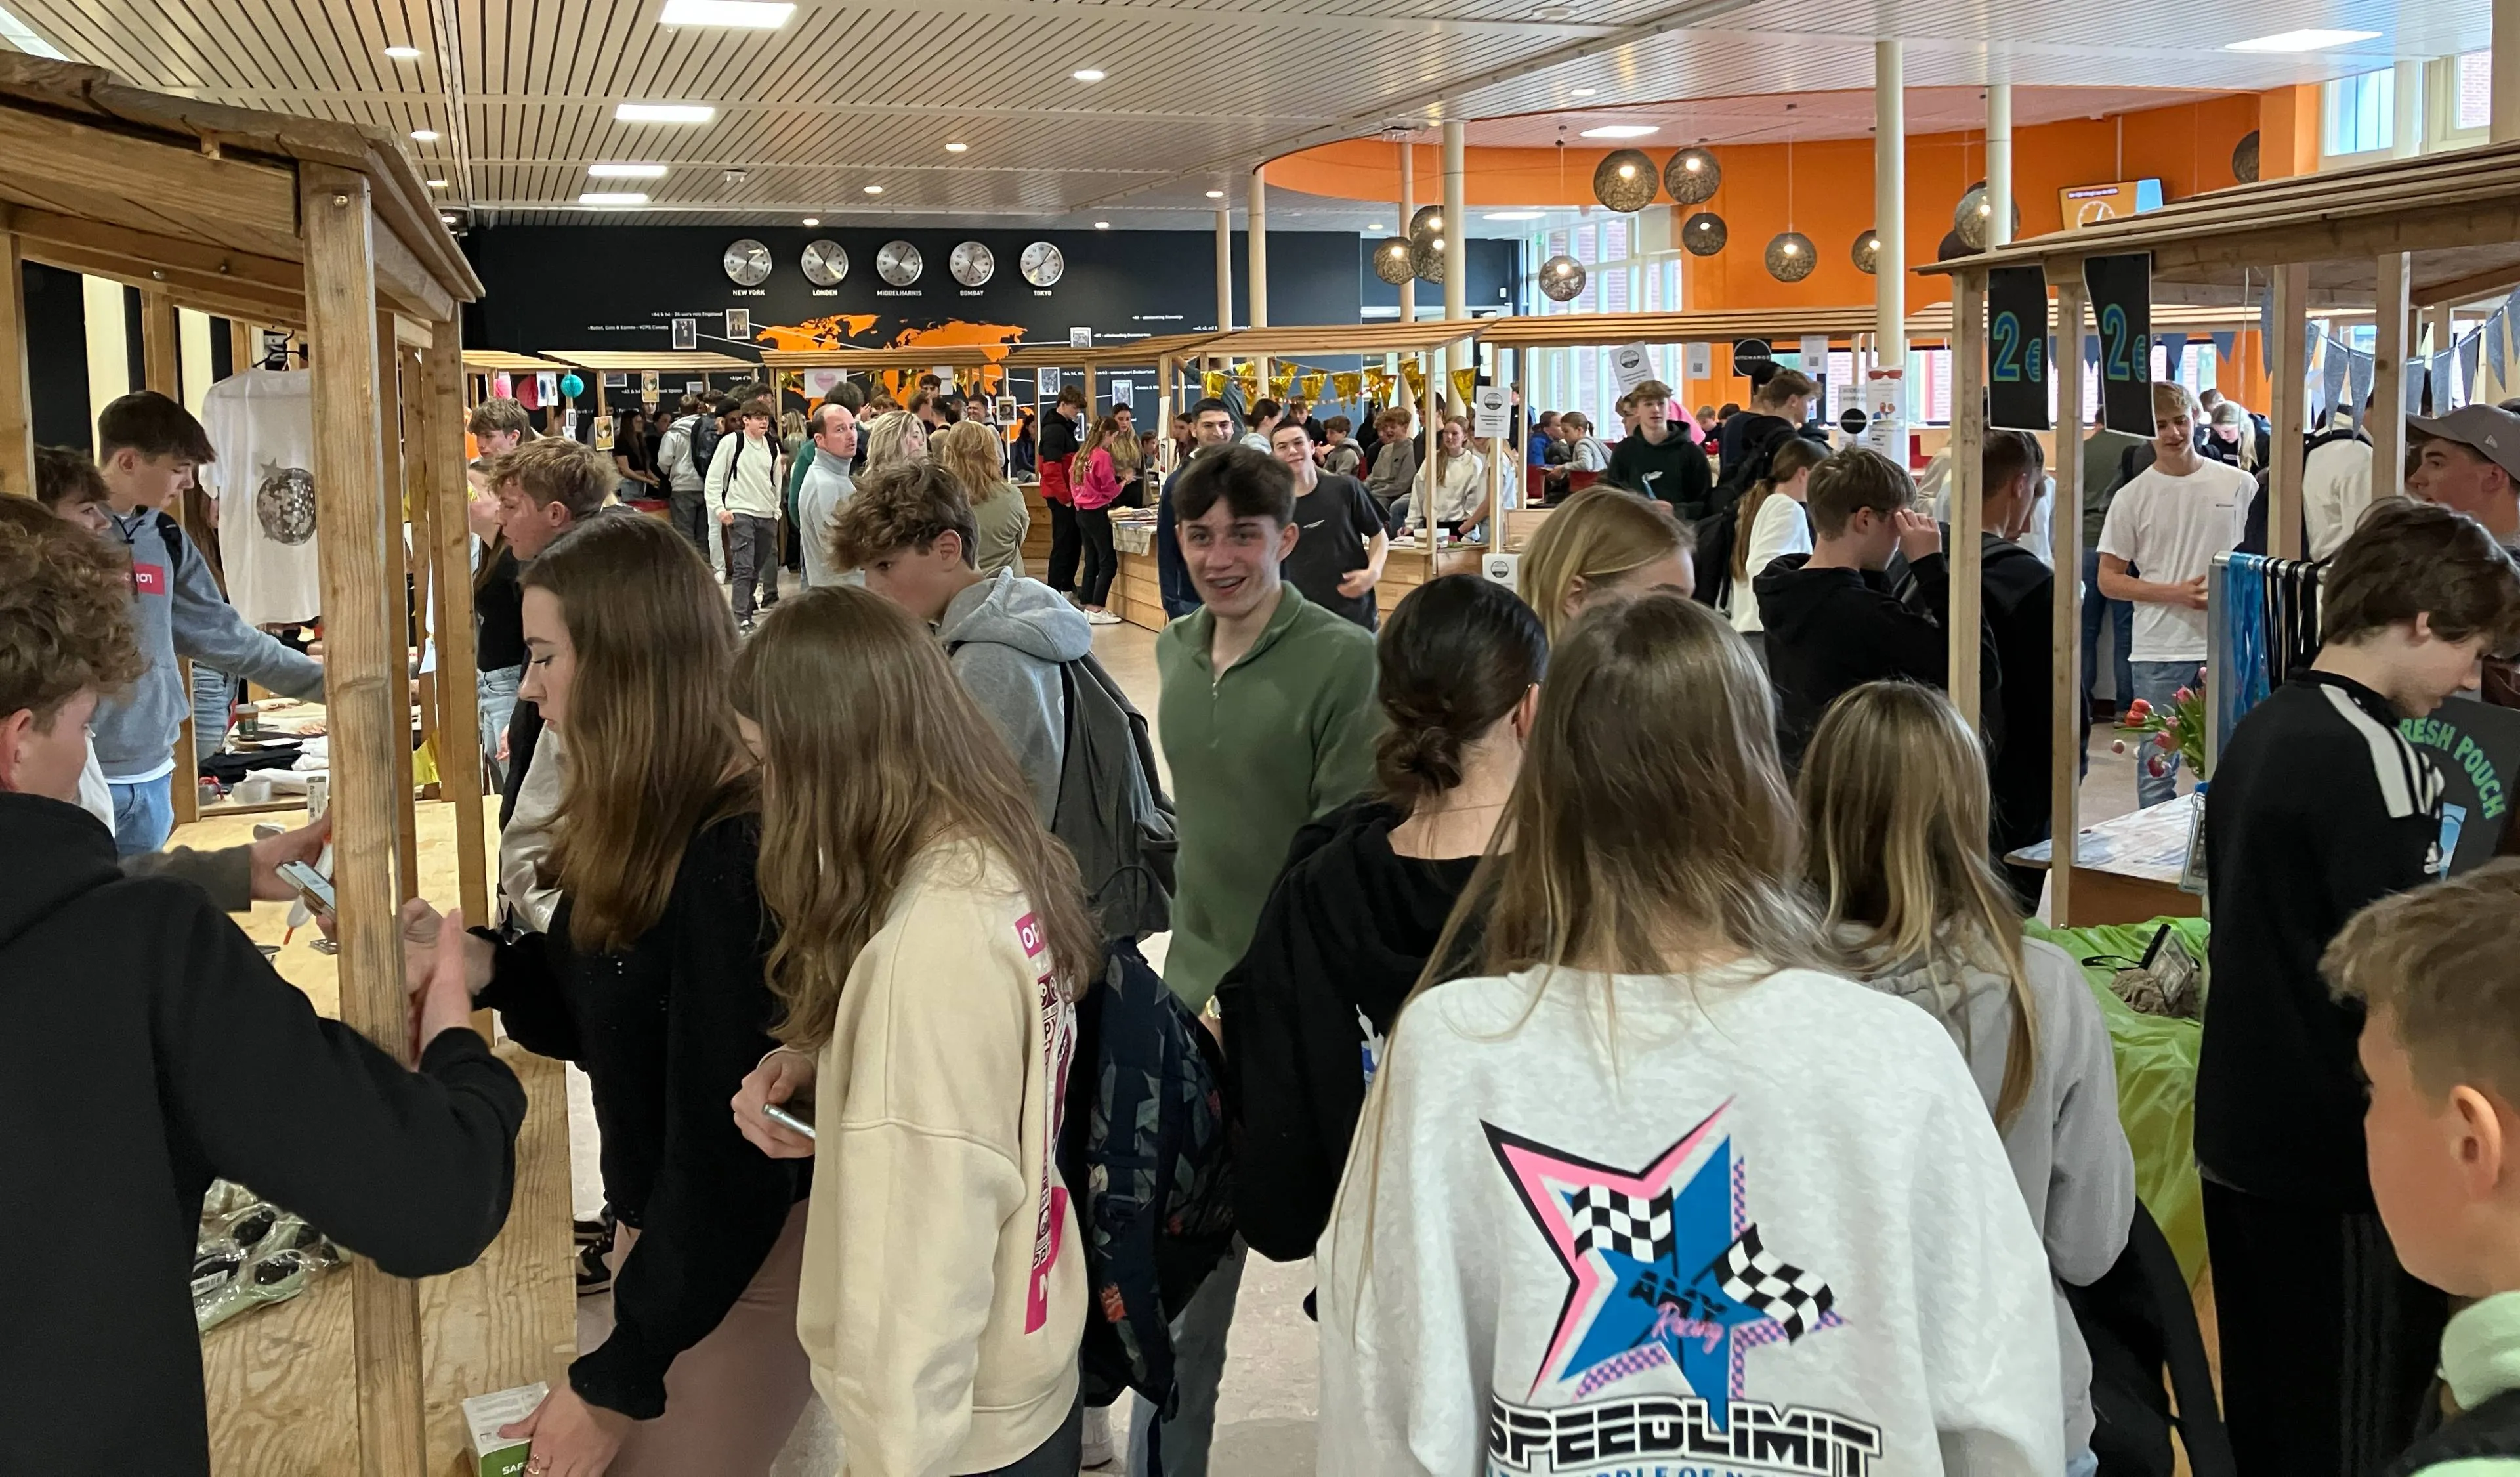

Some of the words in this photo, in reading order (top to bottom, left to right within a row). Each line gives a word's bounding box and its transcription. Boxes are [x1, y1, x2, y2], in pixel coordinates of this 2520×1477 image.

[2399, 717, 2456, 752] RESH
[2453, 735, 2506, 819] POUCH
[502, 1461, 525, 1476] SAF
